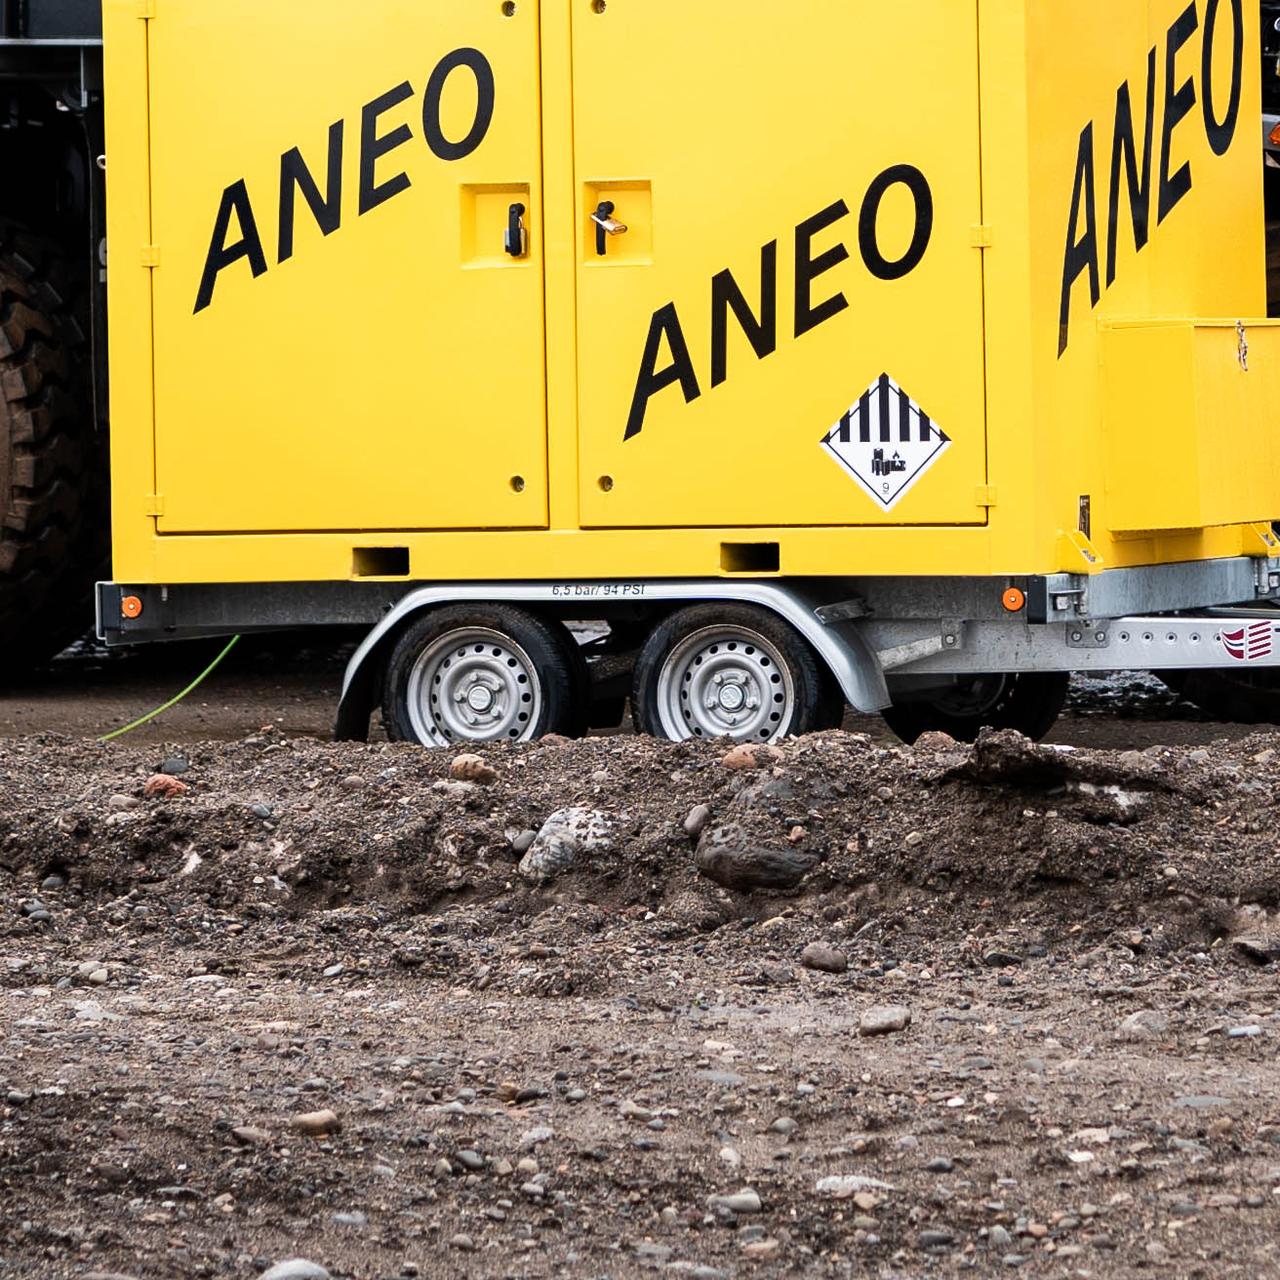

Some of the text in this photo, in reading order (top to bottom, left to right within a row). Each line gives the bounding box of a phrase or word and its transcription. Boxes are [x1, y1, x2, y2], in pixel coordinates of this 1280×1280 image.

[193, 47, 495, 315] ANEO
[623, 164, 933, 443] ANEO
[882, 482, 890, 493] 9
[552, 584, 572, 597] 6,5
[603, 584, 619, 595] 94
[623, 584, 646, 595] PSI
